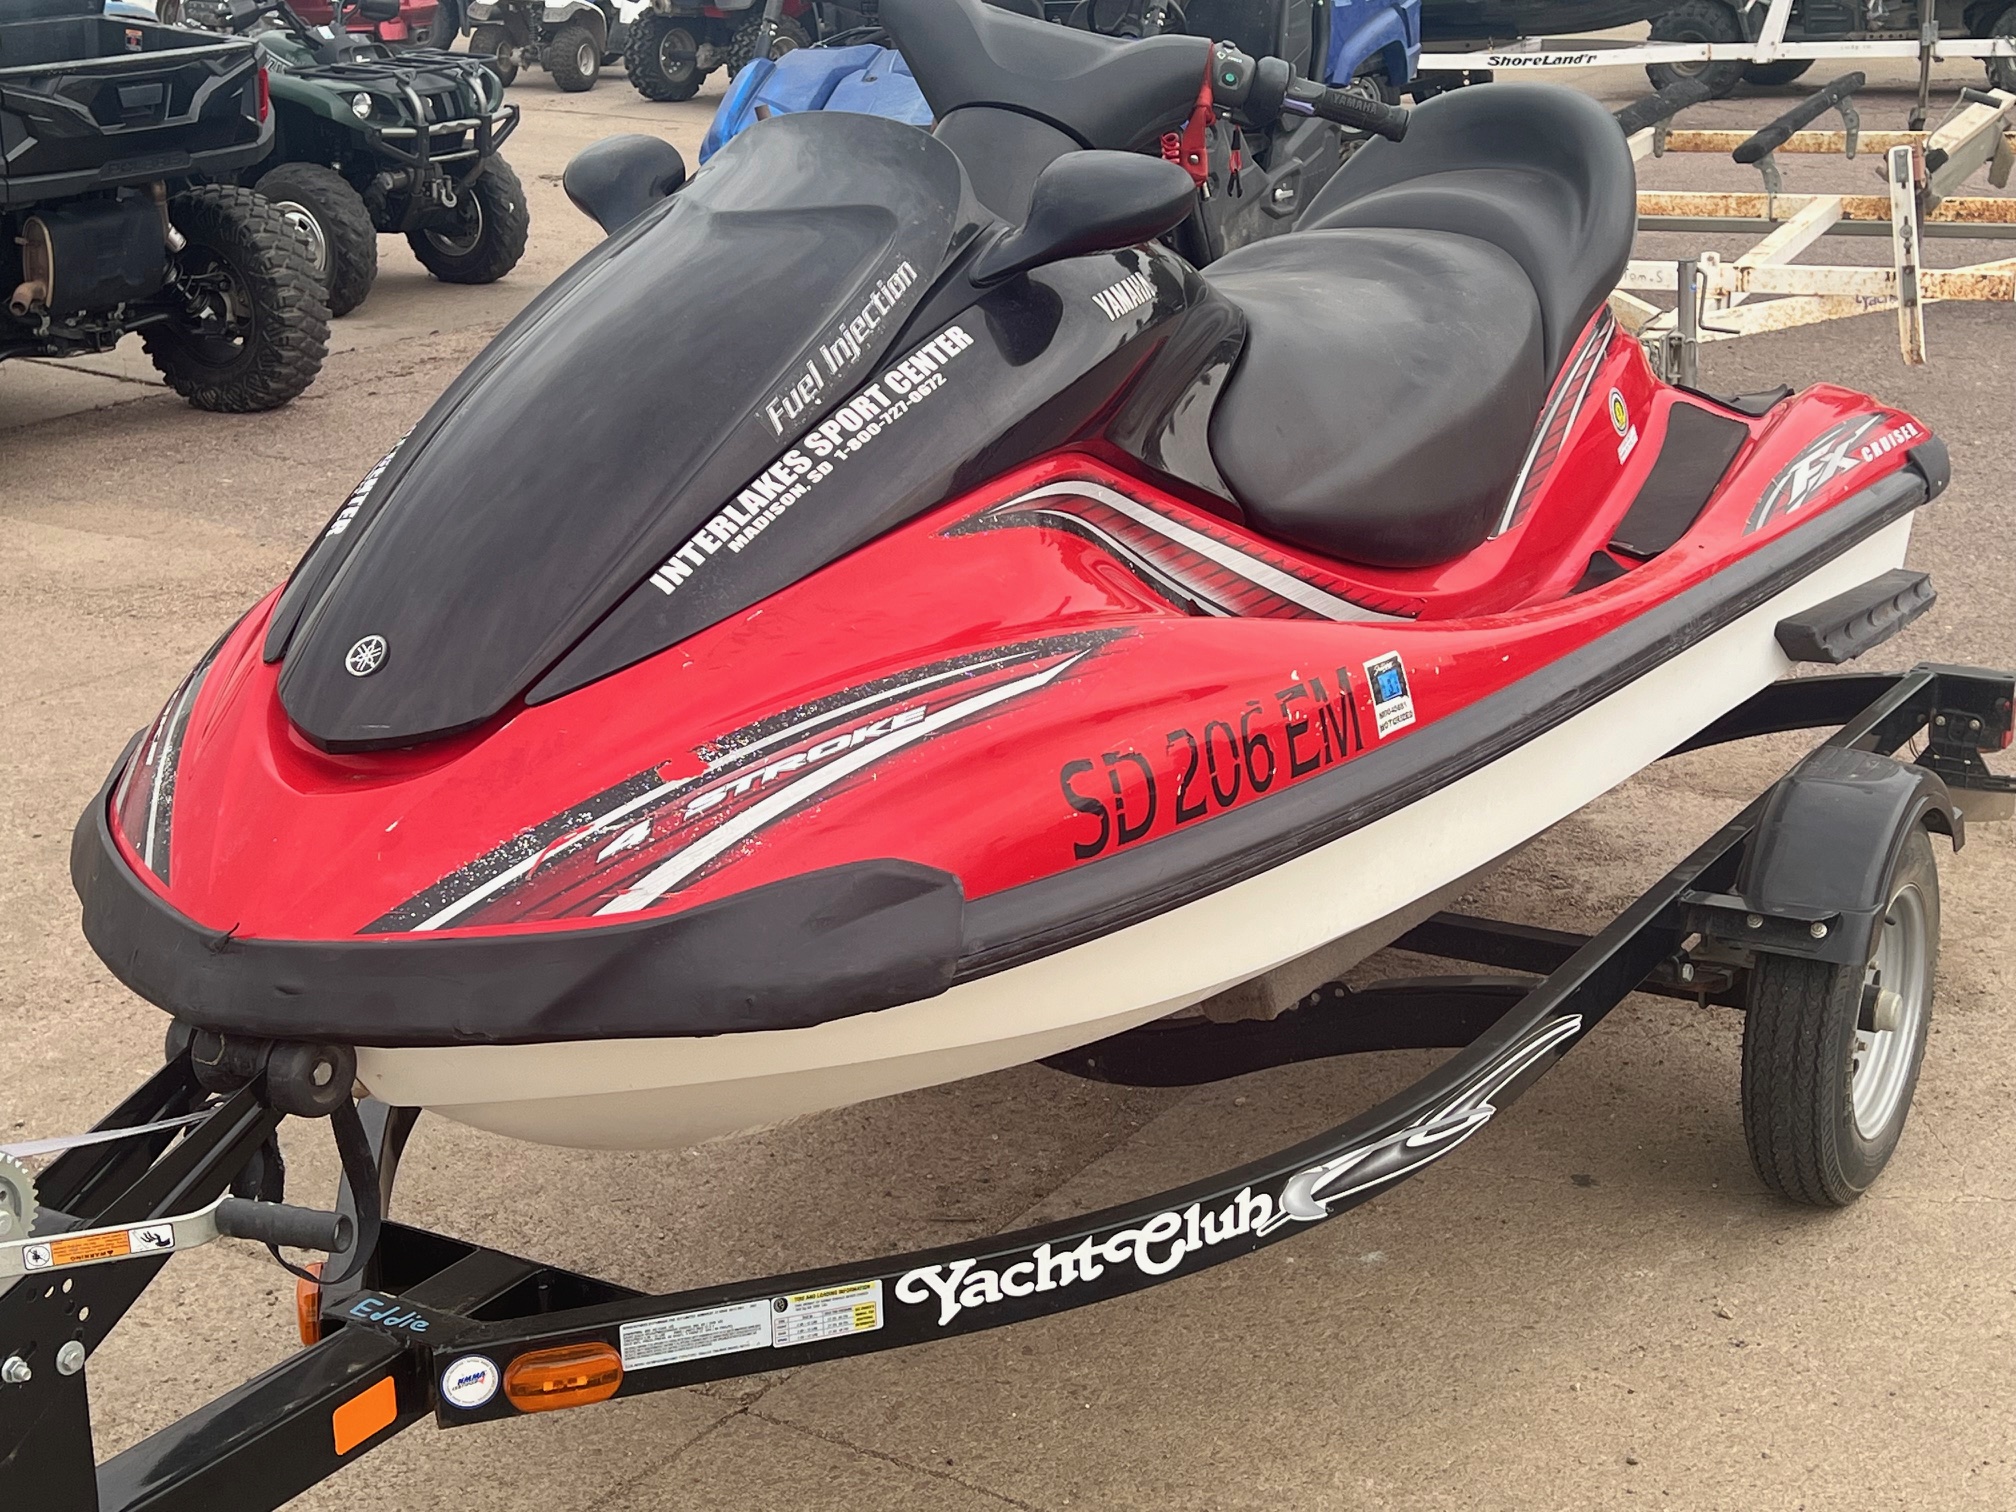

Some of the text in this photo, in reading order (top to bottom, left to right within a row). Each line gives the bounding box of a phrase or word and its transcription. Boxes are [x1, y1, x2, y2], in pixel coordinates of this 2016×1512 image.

[1333, 93, 1378, 115] YAMAHA
[1487, 54, 1598, 66] ShoreLand'r
[765, 261, 918, 436] Fuel Injection
[1091, 271, 1157, 322] YAMAHA
[649, 325, 974, 596] INTERLAKES SPORT CENTER
[727, 372, 947, 553] MADISON, SD 1-800-727-0672
[1784, 414, 1920, 515] FX CRUISER
[684, 704, 929, 820] STROKE
[1060, 667, 1364, 861] SD 206 EM
[895, 1186, 1274, 1327] Yacht Club
[350, 1298, 430, 1332] Eddie
